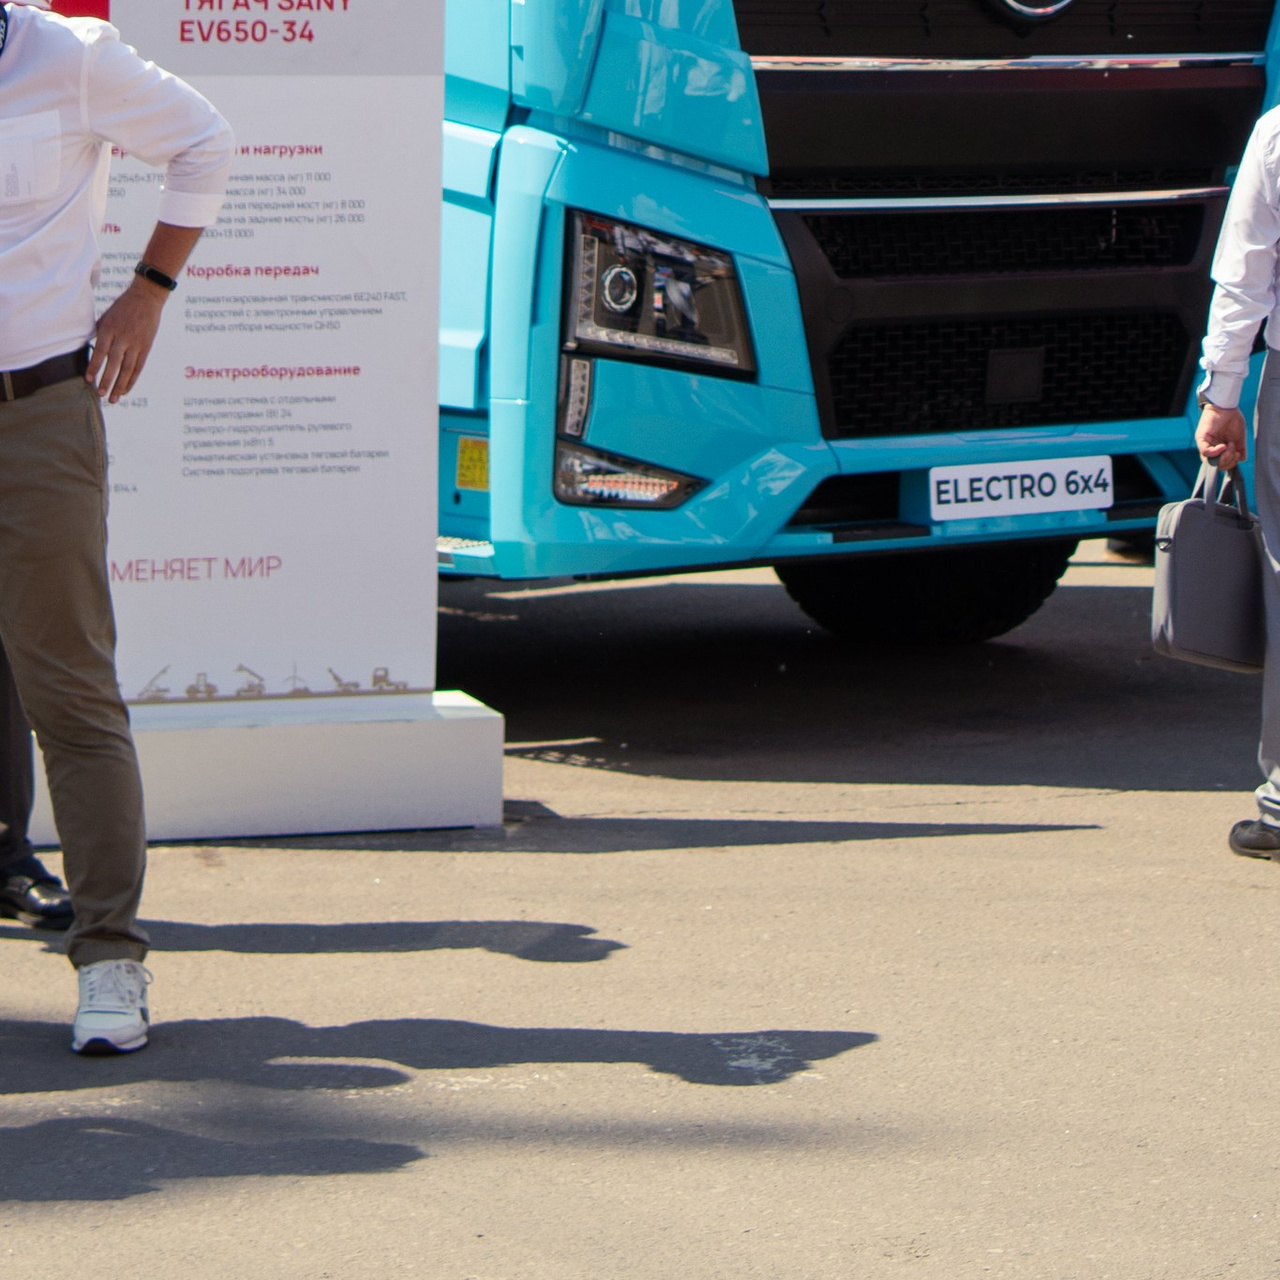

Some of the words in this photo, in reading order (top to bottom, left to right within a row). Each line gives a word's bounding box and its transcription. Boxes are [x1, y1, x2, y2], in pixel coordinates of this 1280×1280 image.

[179, 20, 316, 43] EV650-34
[253, 144, 323, 158] нагрузки
[186, 264, 252, 280] Коробка
[254, 264, 320, 280] передач
[184, 364, 362, 382] Электрооборудование
[934, 471, 1058, 506] ELECTRO
[110, 555, 218, 583] МЕНЯЕТ
[223, 555, 282, 580] МИР
